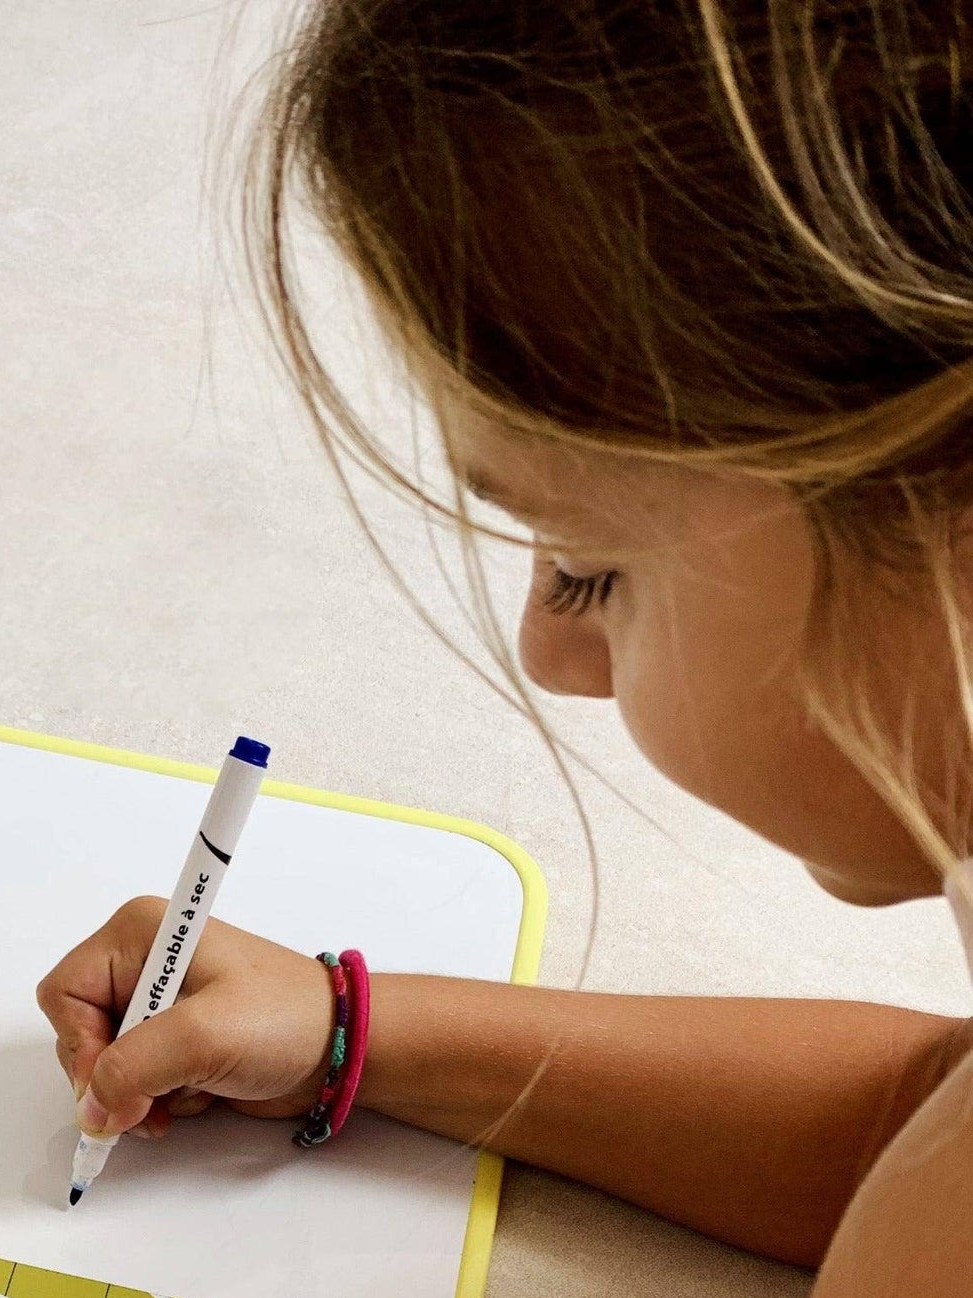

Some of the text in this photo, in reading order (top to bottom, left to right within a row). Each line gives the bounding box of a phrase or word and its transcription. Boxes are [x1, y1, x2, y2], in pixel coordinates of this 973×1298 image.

[148, 872, 210, 1011] effaçable à sec
